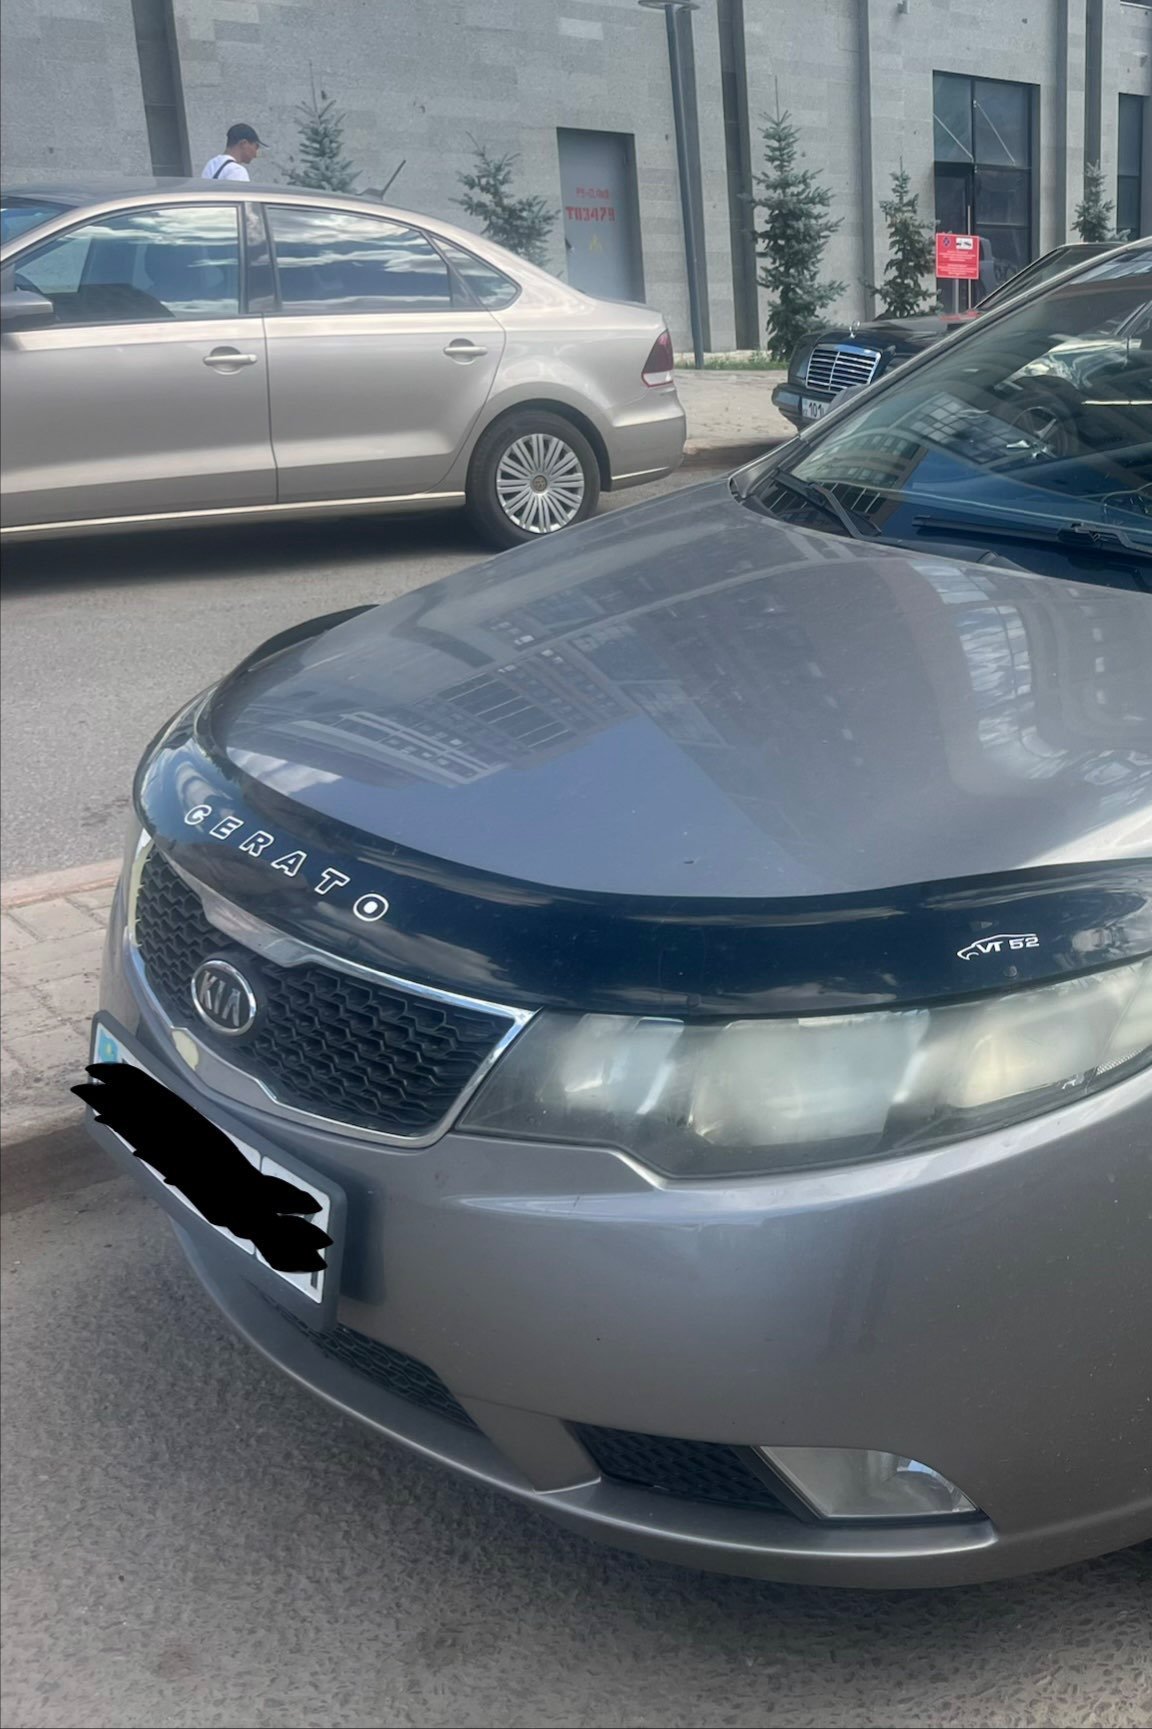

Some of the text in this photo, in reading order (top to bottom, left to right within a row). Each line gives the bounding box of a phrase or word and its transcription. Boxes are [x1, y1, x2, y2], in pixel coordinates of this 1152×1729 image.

[184, 804, 389, 922] CERATO
[976, 937, 1040, 953] VT 52
[200, 970, 241, 1027] KIA
